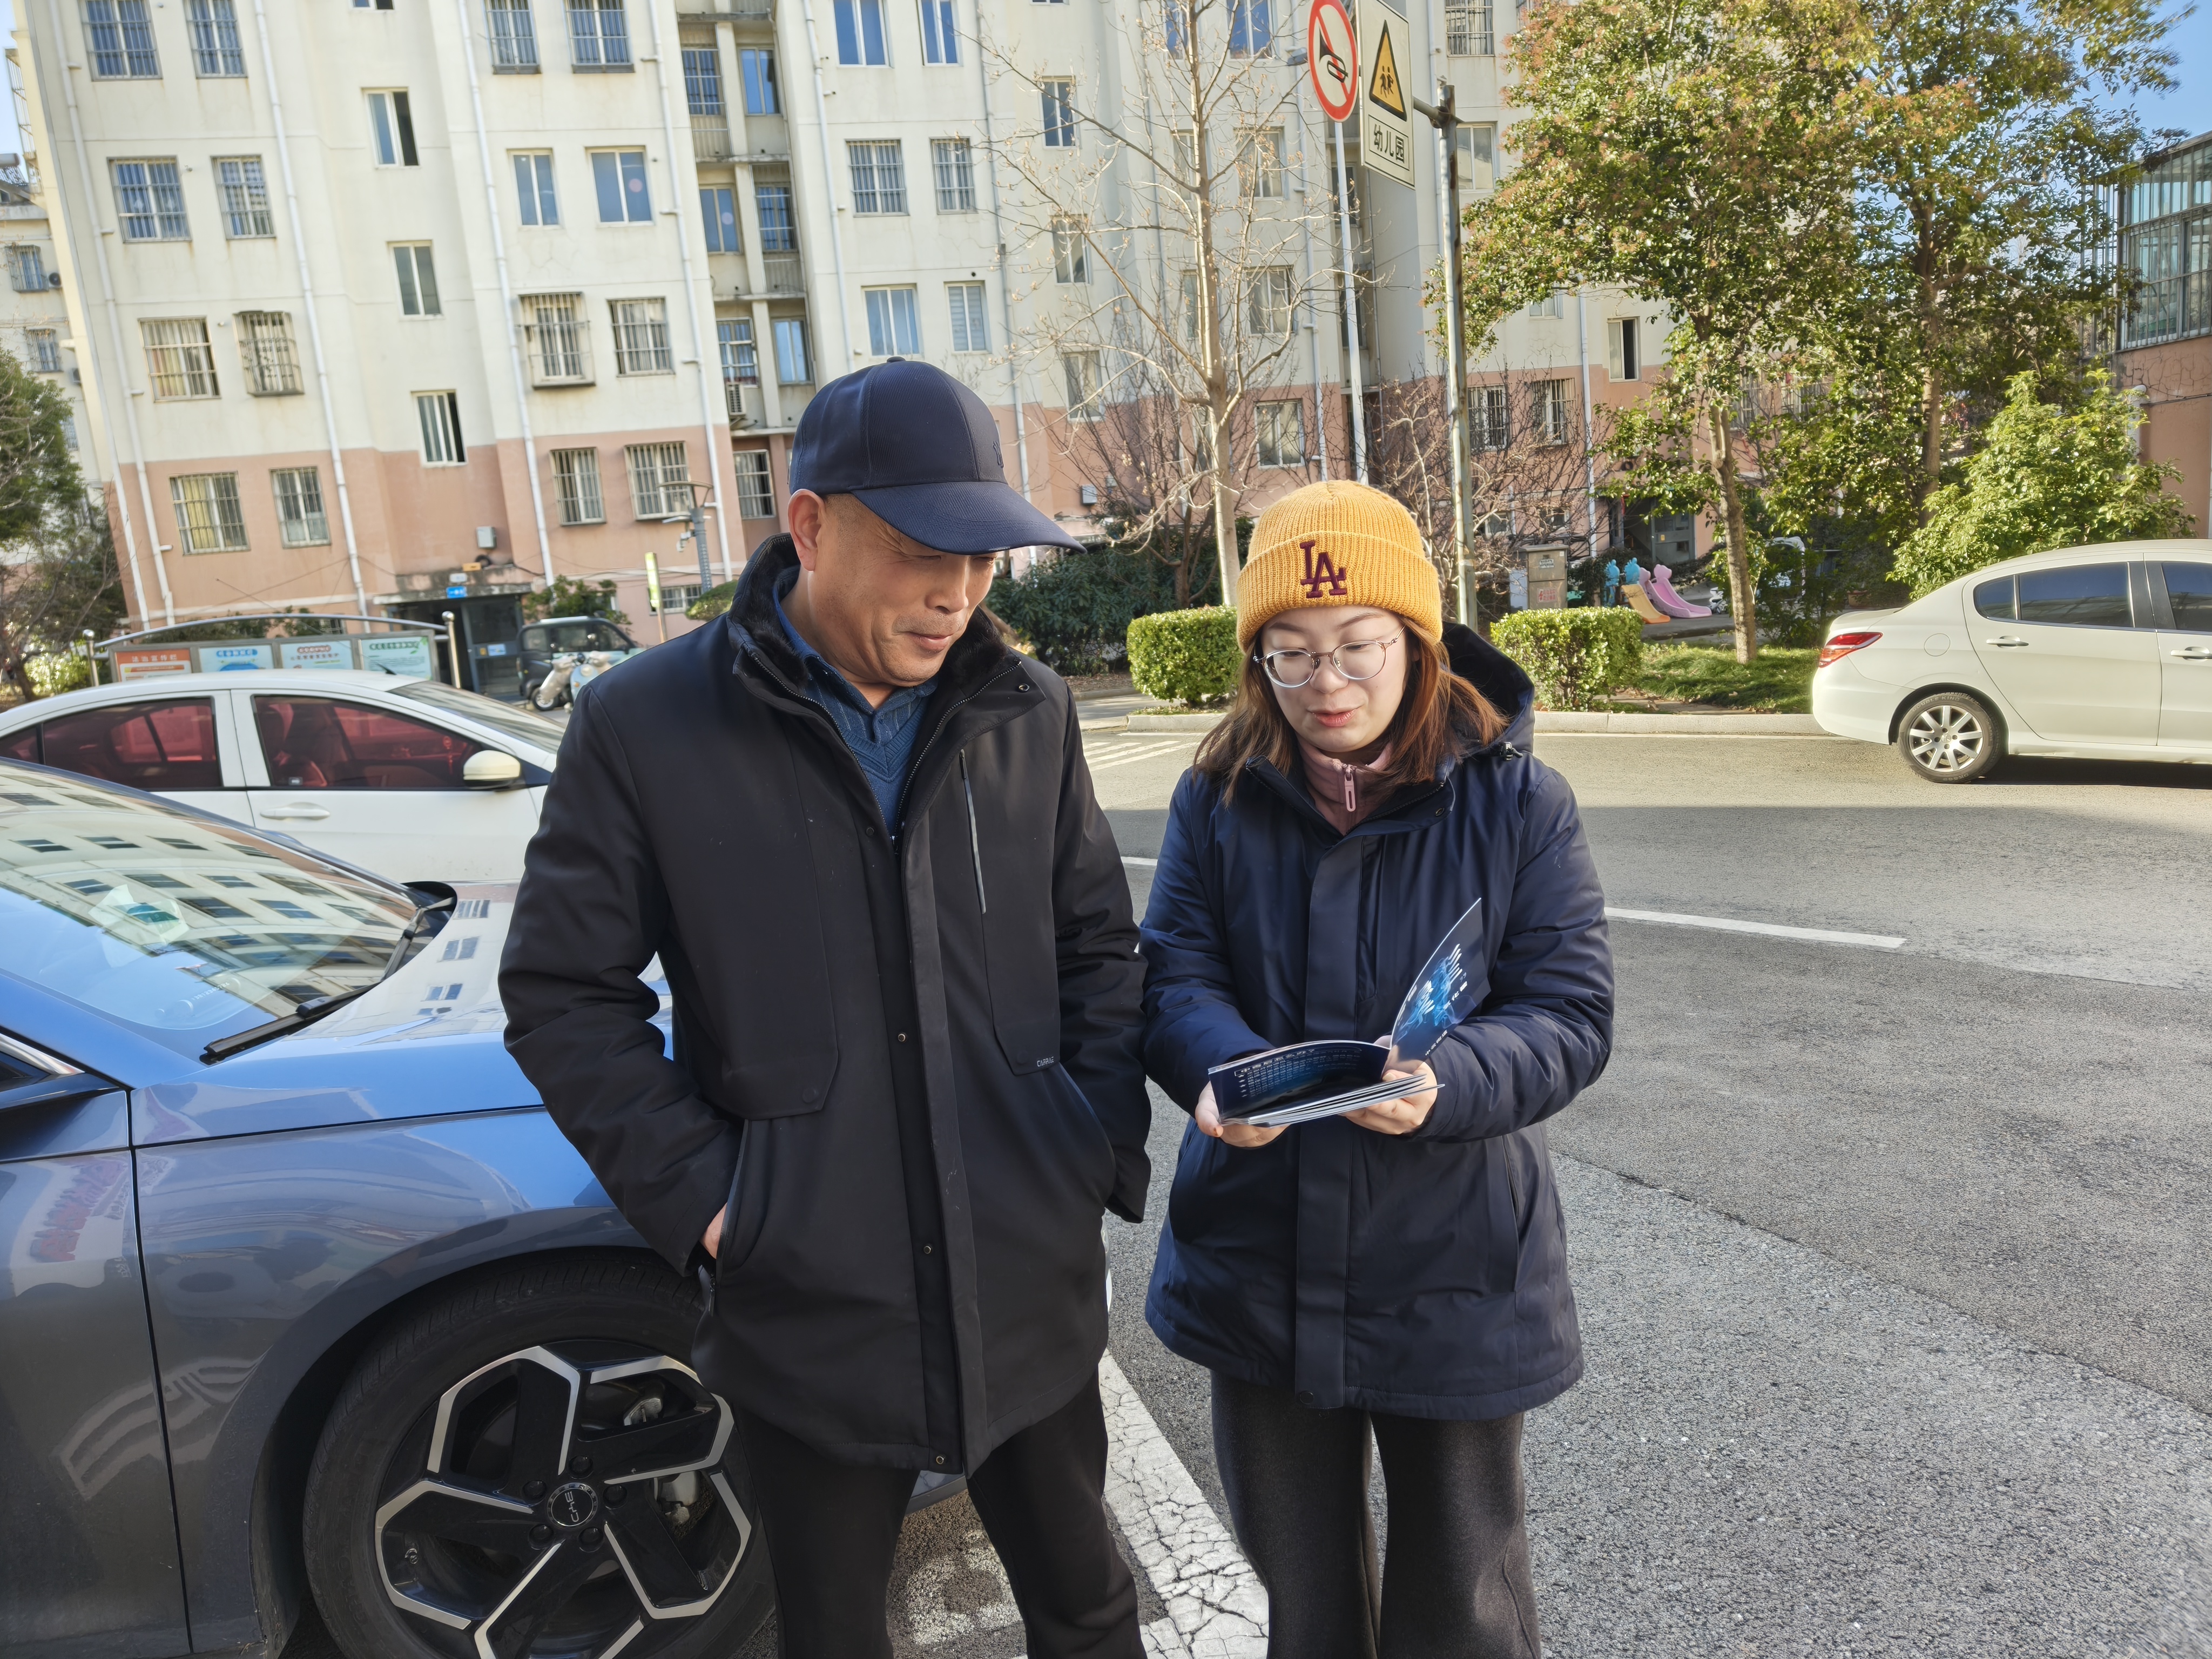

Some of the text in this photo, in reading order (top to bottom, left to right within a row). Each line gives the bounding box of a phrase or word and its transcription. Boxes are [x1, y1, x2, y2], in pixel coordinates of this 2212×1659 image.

[1373, 124, 1405, 163] 幼儿园
[1299, 540, 1348, 598] LA
[1912, 697, 1939, 712] DOUBLE
